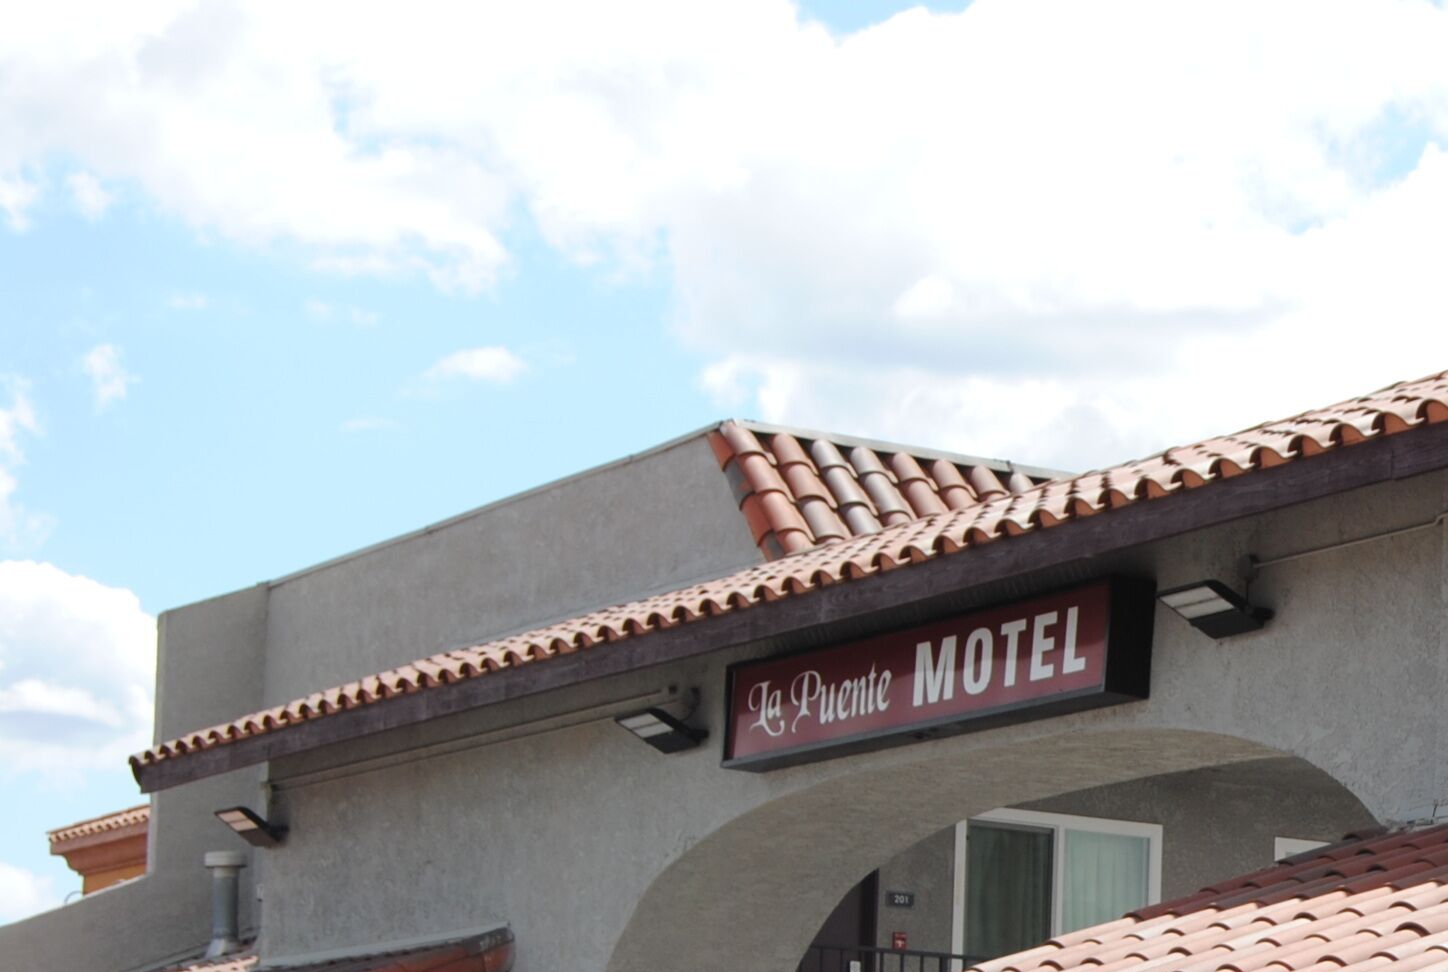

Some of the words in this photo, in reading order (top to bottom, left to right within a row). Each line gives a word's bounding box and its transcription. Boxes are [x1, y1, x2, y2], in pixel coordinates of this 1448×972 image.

[748, 680, 784, 737] La
[791, 661, 892, 734] Puente
[912, 606, 1087, 707] MOTEL
[894, 894, 909, 904] 201
